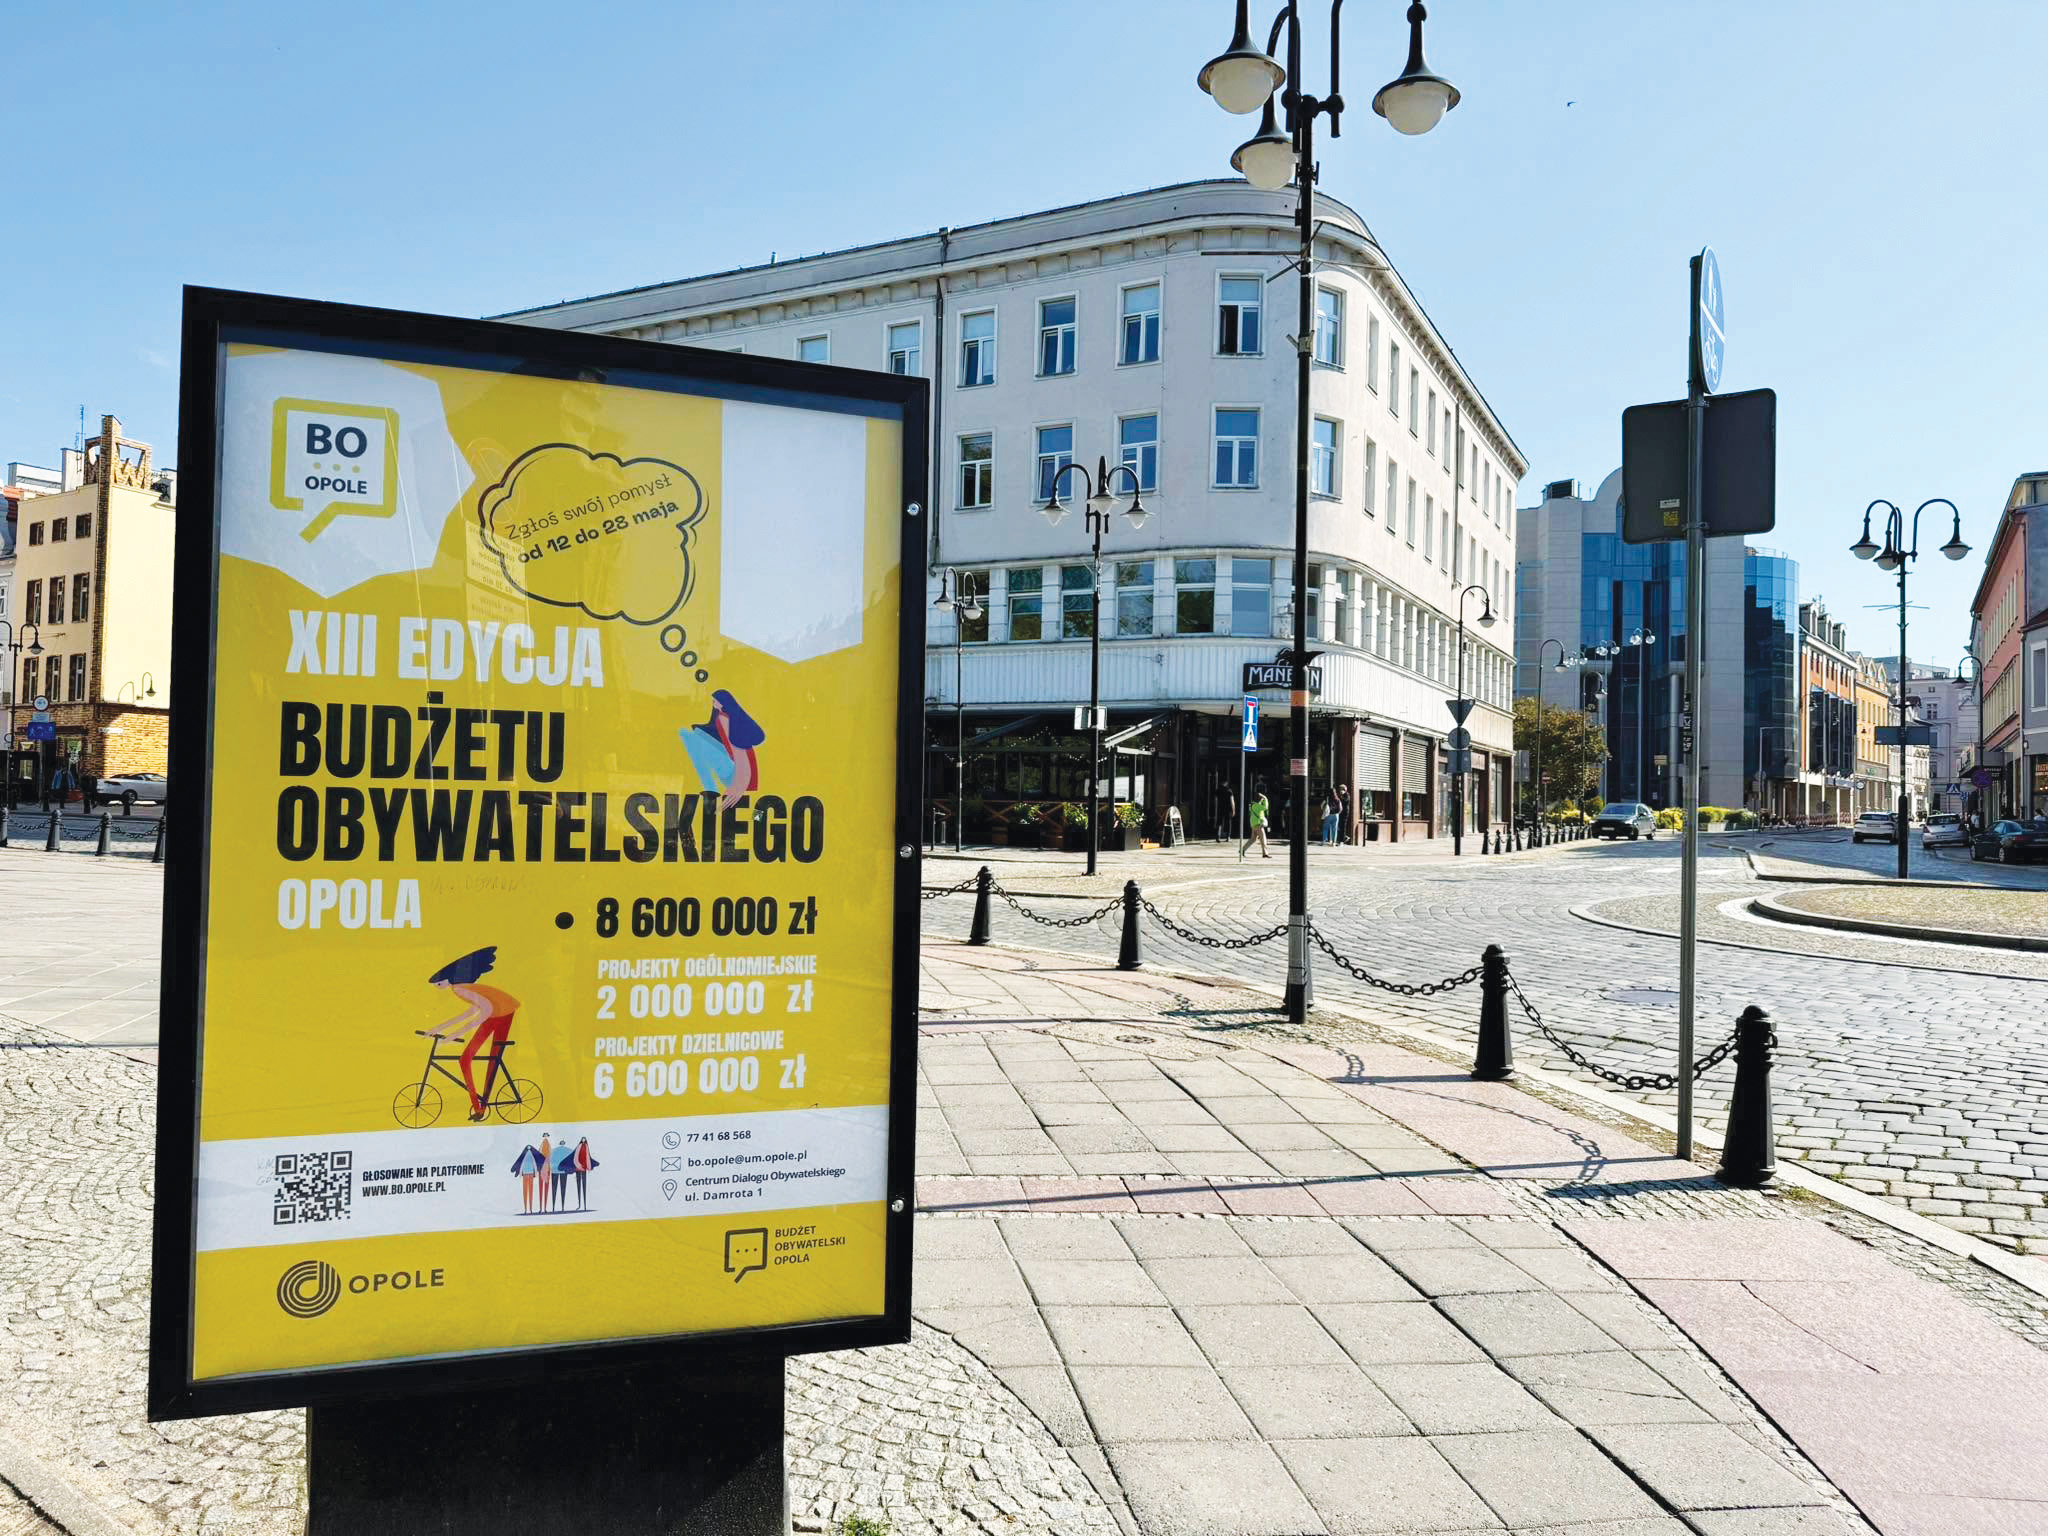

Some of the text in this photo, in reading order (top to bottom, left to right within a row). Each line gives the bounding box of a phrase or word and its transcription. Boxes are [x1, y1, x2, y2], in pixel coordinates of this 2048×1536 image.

[305, 423, 368, 459] BO
[304, 475, 368, 495] OPOLE
[504, 473, 673, 540] Zgłoś swój pomysł
[518, 501, 680, 564] od 12 do 28 maja
[285, 609, 605, 688] XIII EDYCJA
[1248, 666, 1320, 689] MANEN
[279, 690, 565, 784] BUDŻETU
[276, 785, 825, 864] OBYWATELSKIEGO
[277, 877, 422, 930] OPOLA
[596, 895, 818, 938] 8 600 000 zł
[597, 952, 818, 980] PROJEKTY OGÓLNOMIEJSKIE
[596, 979, 815, 1020] 2 000 000 zł
[594, 1030, 785, 1057] PROJEKTY DZIELNICOWE
[594, 1053, 807, 1099] 6 600 000 zł
[686, 1130, 752, 1143] 77 41 68 568
[416, 1166, 429, 1178] NA
[430, 1164, 485, 1178] PLATFORMIE
[687, 1149, 808, 1168] bo.opole@um.opole.pl
[362, 1181, 447, 1197] WWW.BO.OPOLE.PL
[685, 1167, 846, 1187] Centrum Dialogu Obywatelskiego
[685, 1188, 763, 1202] ul. Damrota 1
[774, 1236, 846, 1252] OBYWATELSKI
[775, 1225, 817, 1238] BUDŻET
[774, 1253, 811, 1266] OPOLA
[348, 1268, 445, 1294] OPOLE
